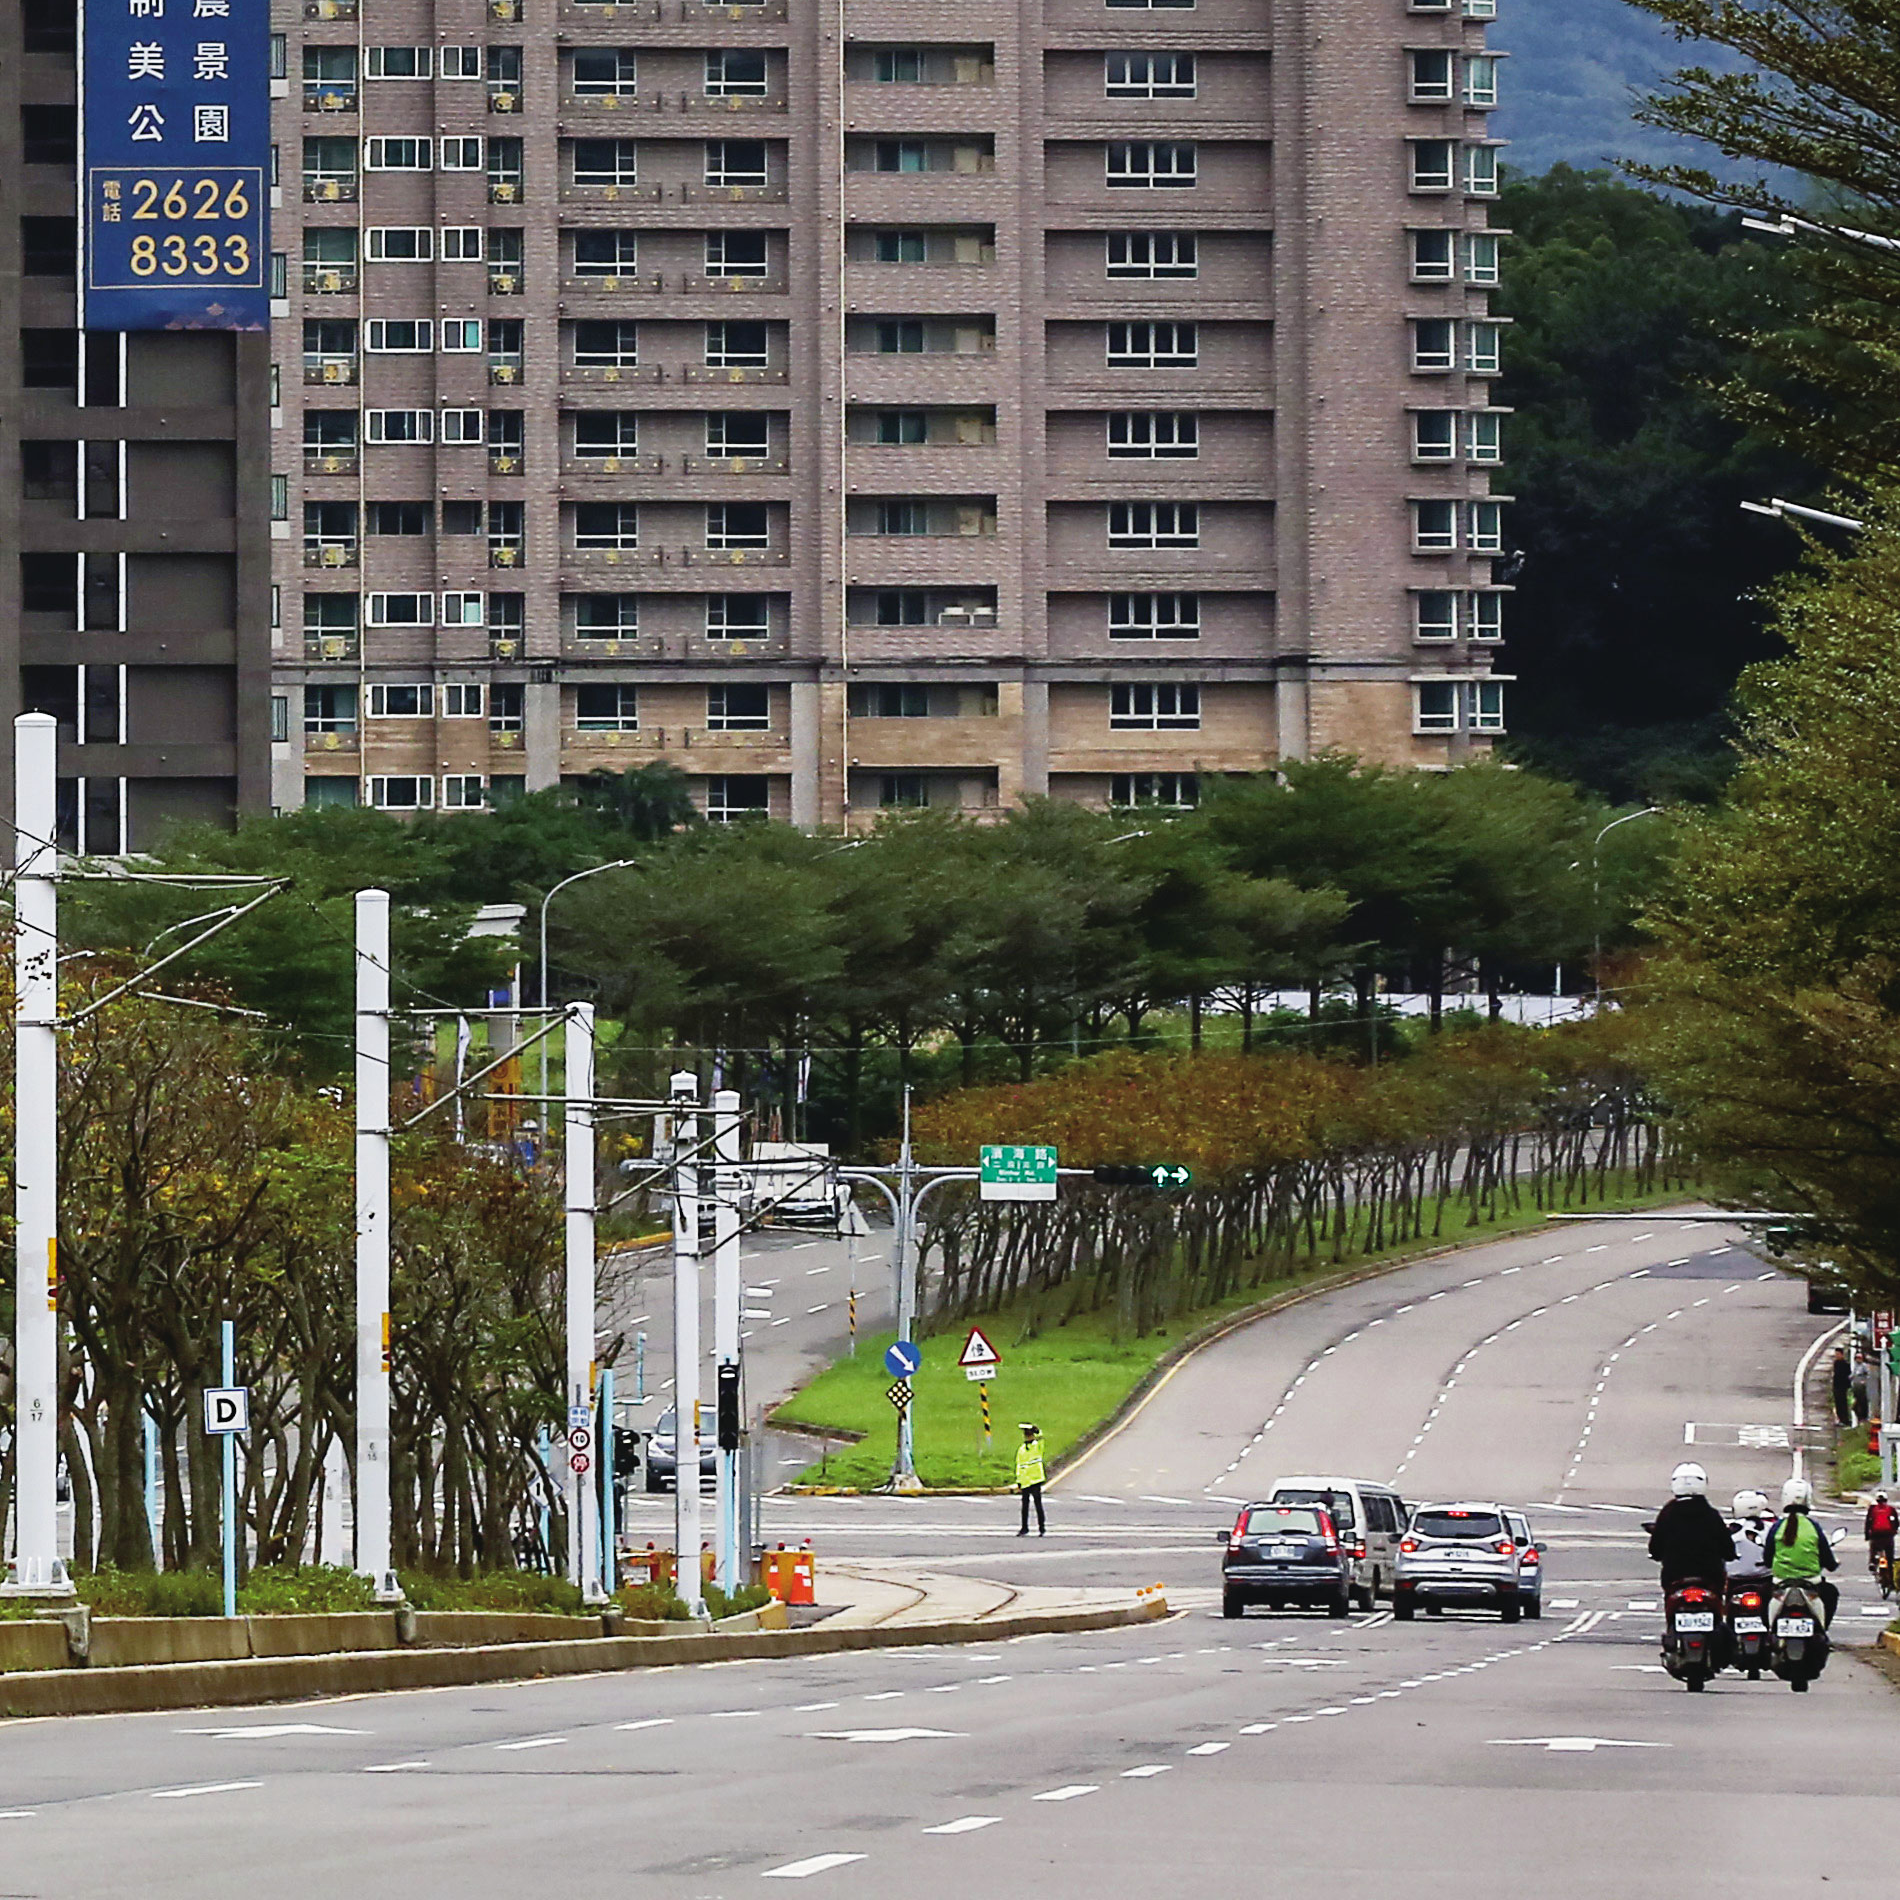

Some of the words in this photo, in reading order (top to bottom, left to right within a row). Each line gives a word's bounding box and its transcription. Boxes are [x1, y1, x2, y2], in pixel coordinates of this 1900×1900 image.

[128, 41, 230, 81] 美景
[127, 104, 230, 143] 公園
[102, 179, 122, 223] 電話
[131, 178, 250, 220] 2626
[130, 234, 250, 277] 8333
[31, 1412, 43, 1422] 17
[216, 1398, 237, 1423] D
[575, 1435, 586, 1444] 10
